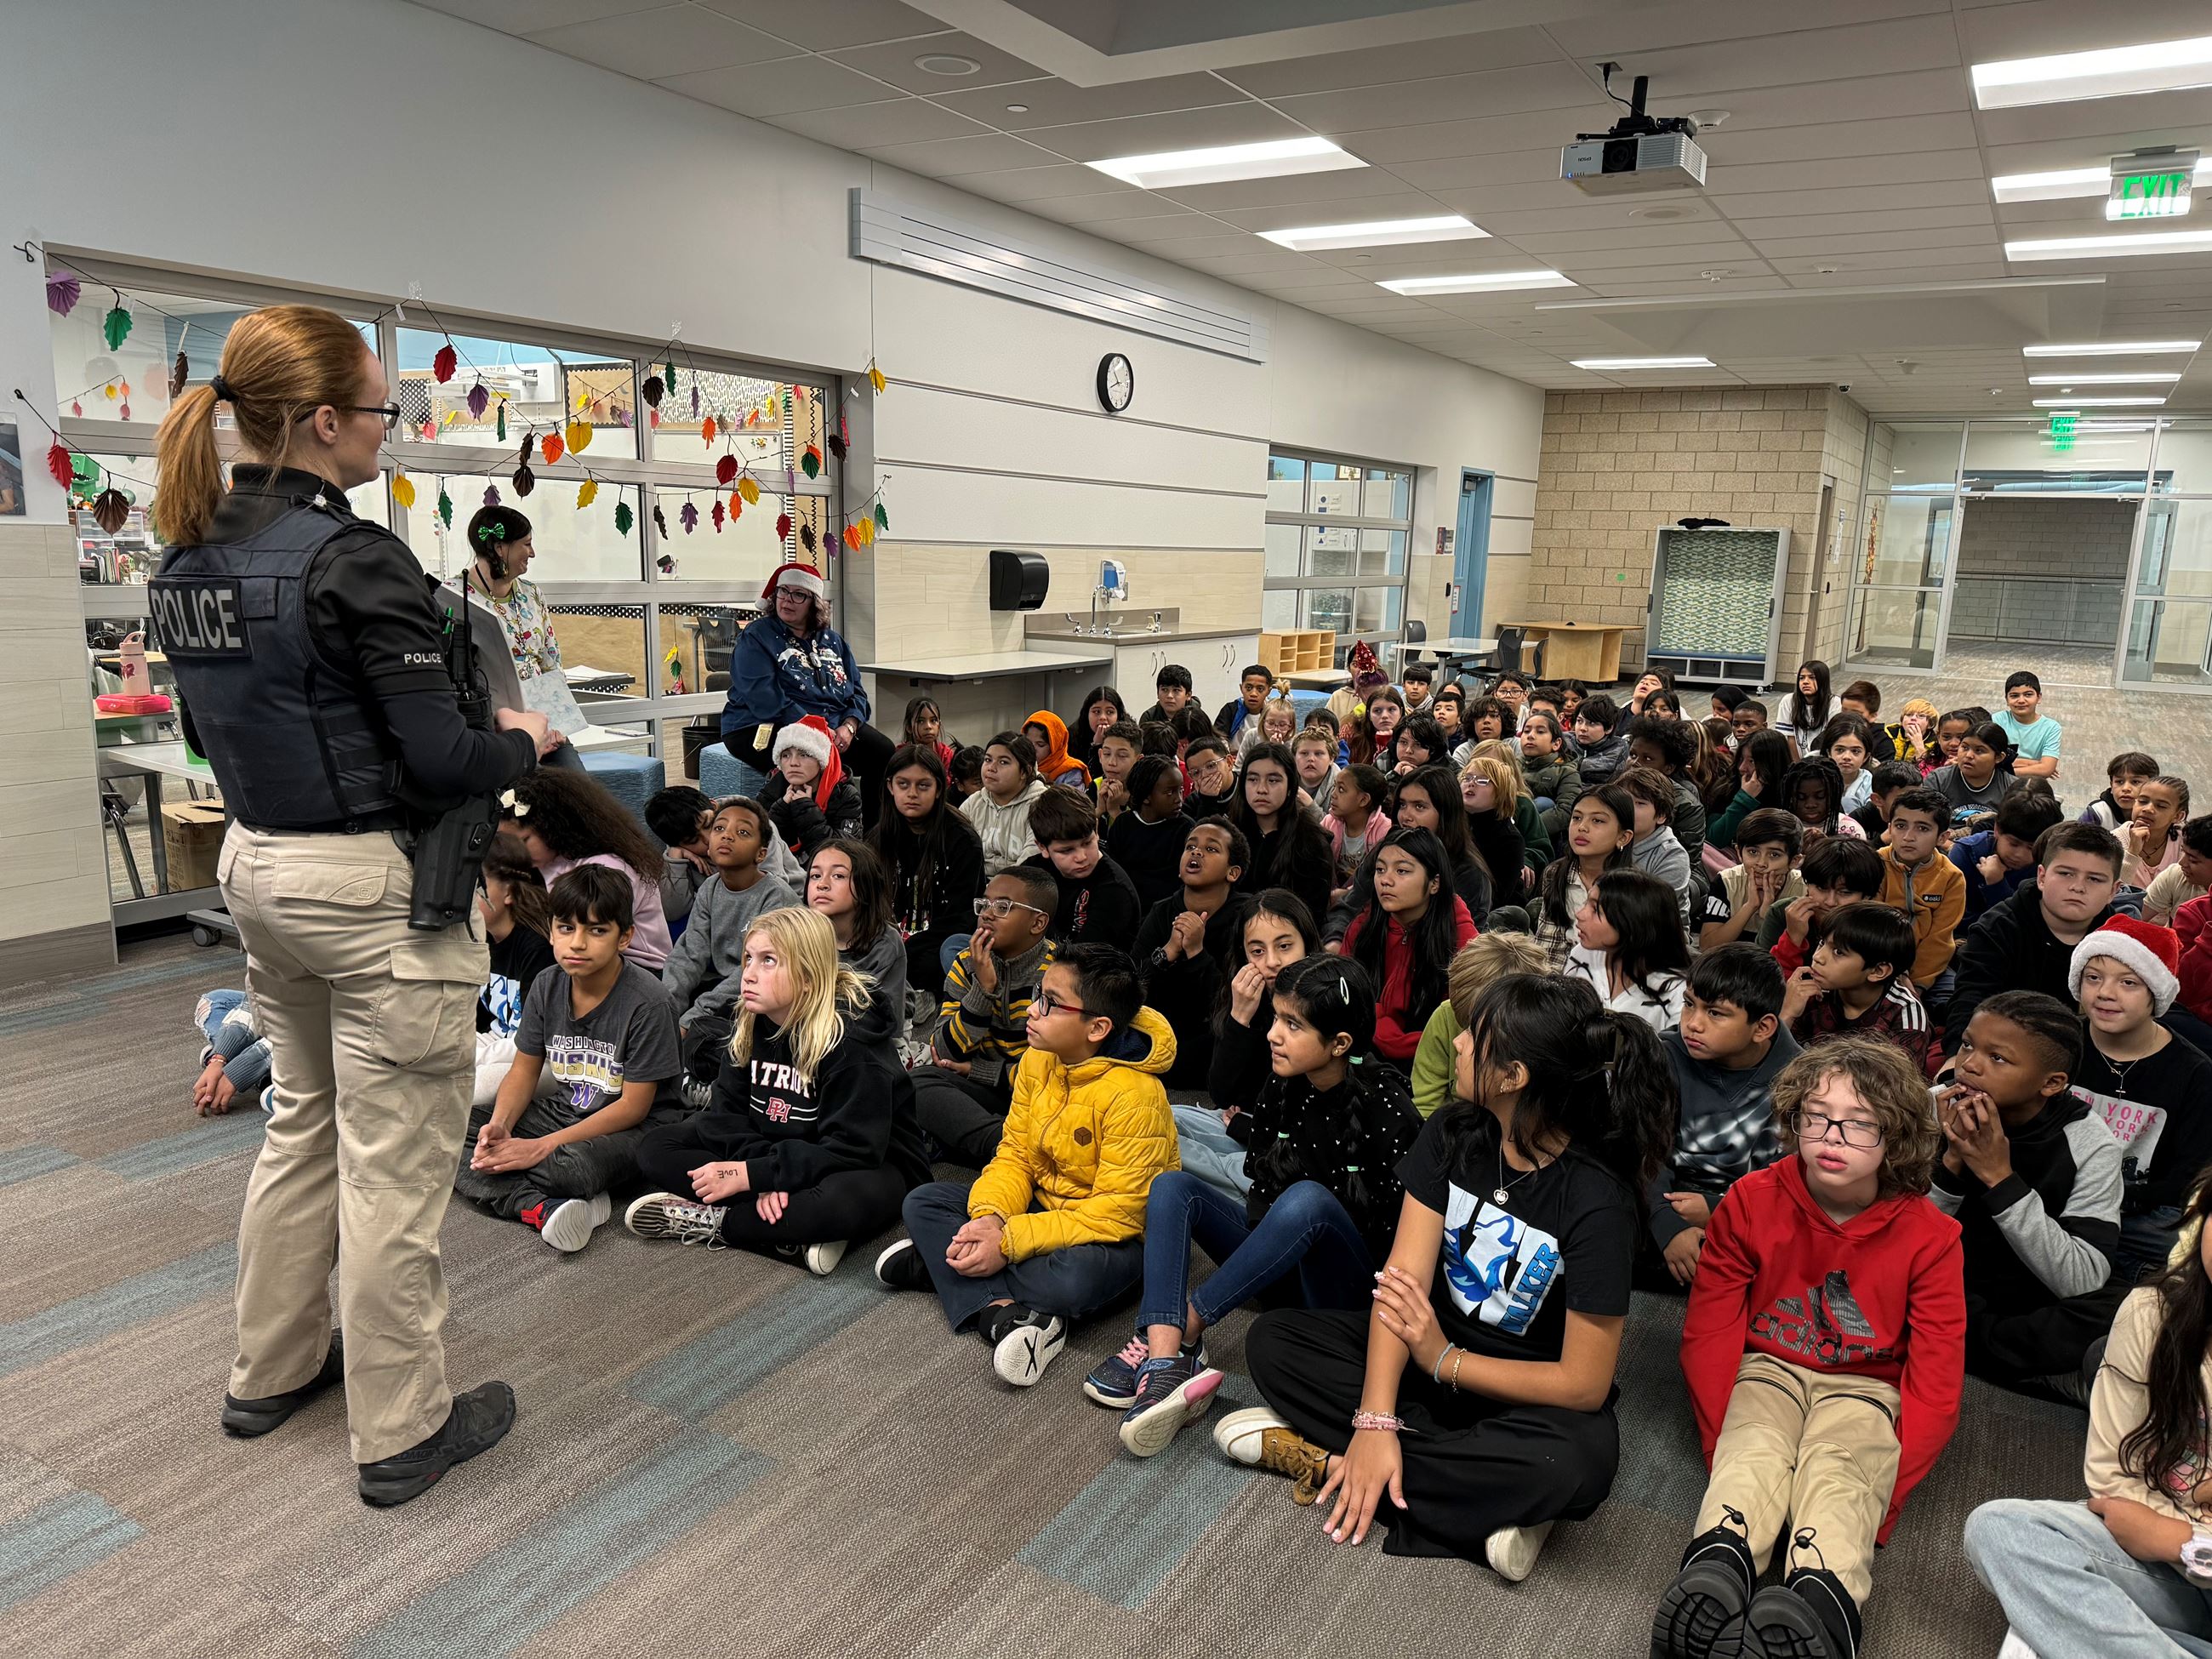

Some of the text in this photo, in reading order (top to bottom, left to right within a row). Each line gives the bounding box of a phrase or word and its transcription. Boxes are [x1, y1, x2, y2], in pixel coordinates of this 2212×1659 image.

[2120, 173, 2186, 218] EXIT
[150, 588, 242, 649] POLICE
[404, 653, 442, 664] POLICE
[552, 1035, 617, 1057] WASHINGTO
[570, 1081, 600, 1109] W
[2107, 1103, 2158, 1124] YORK
[2103, 1116, 2151, 1133] YORK
[2112, 1130, 2144, 1142] ORK
[716, 1169, 738, 1179] LOVE
[1497, 1242, 1560, 1333] WALKER
